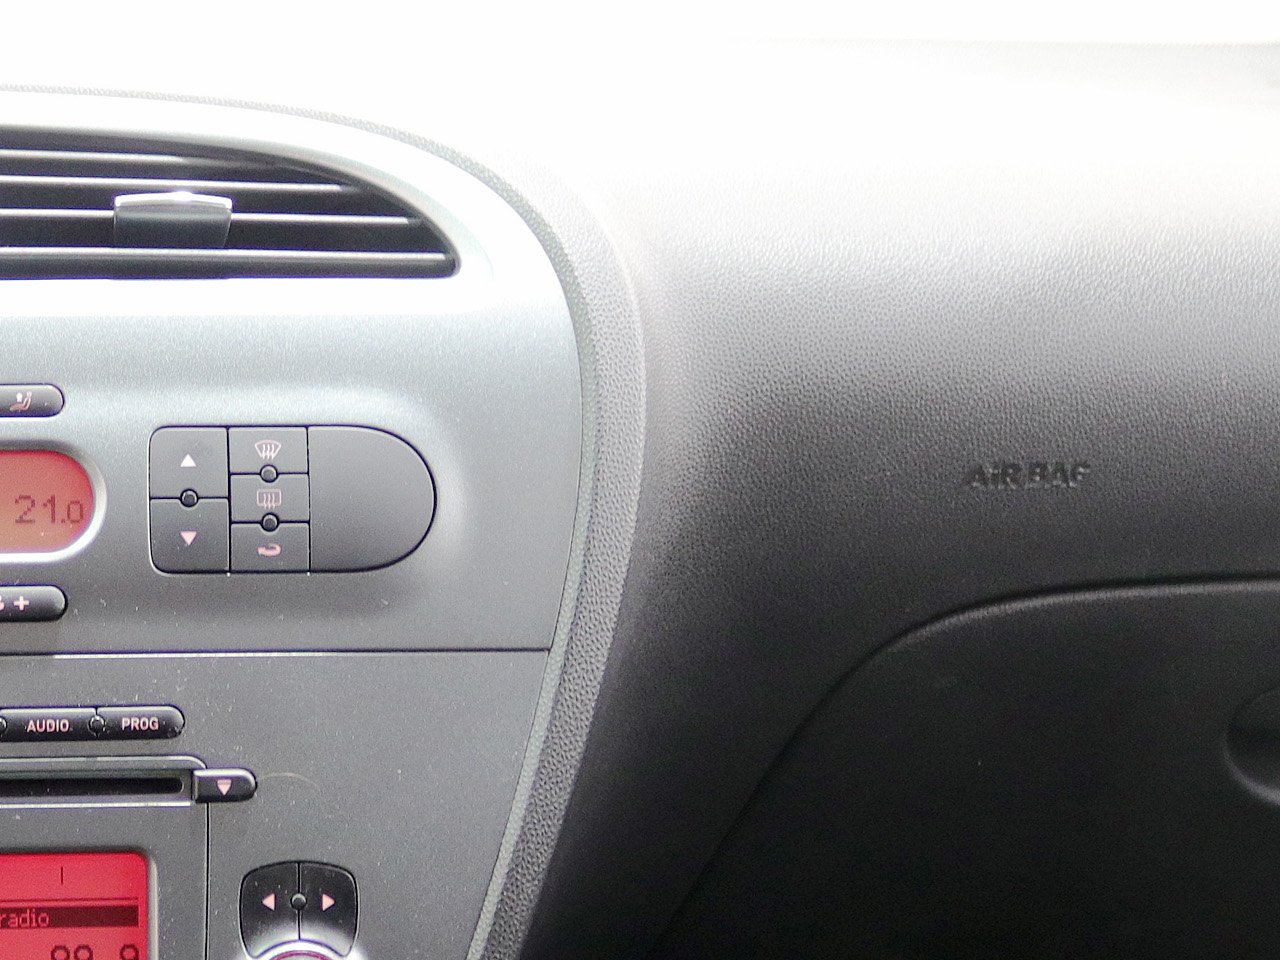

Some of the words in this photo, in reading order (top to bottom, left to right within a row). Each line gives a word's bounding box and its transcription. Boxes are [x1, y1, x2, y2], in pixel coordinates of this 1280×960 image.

[14, 496, 84, 525] 21.0
[27, 719, 70, 733] AUDIO
[121, 717, 160, 731] PROG
